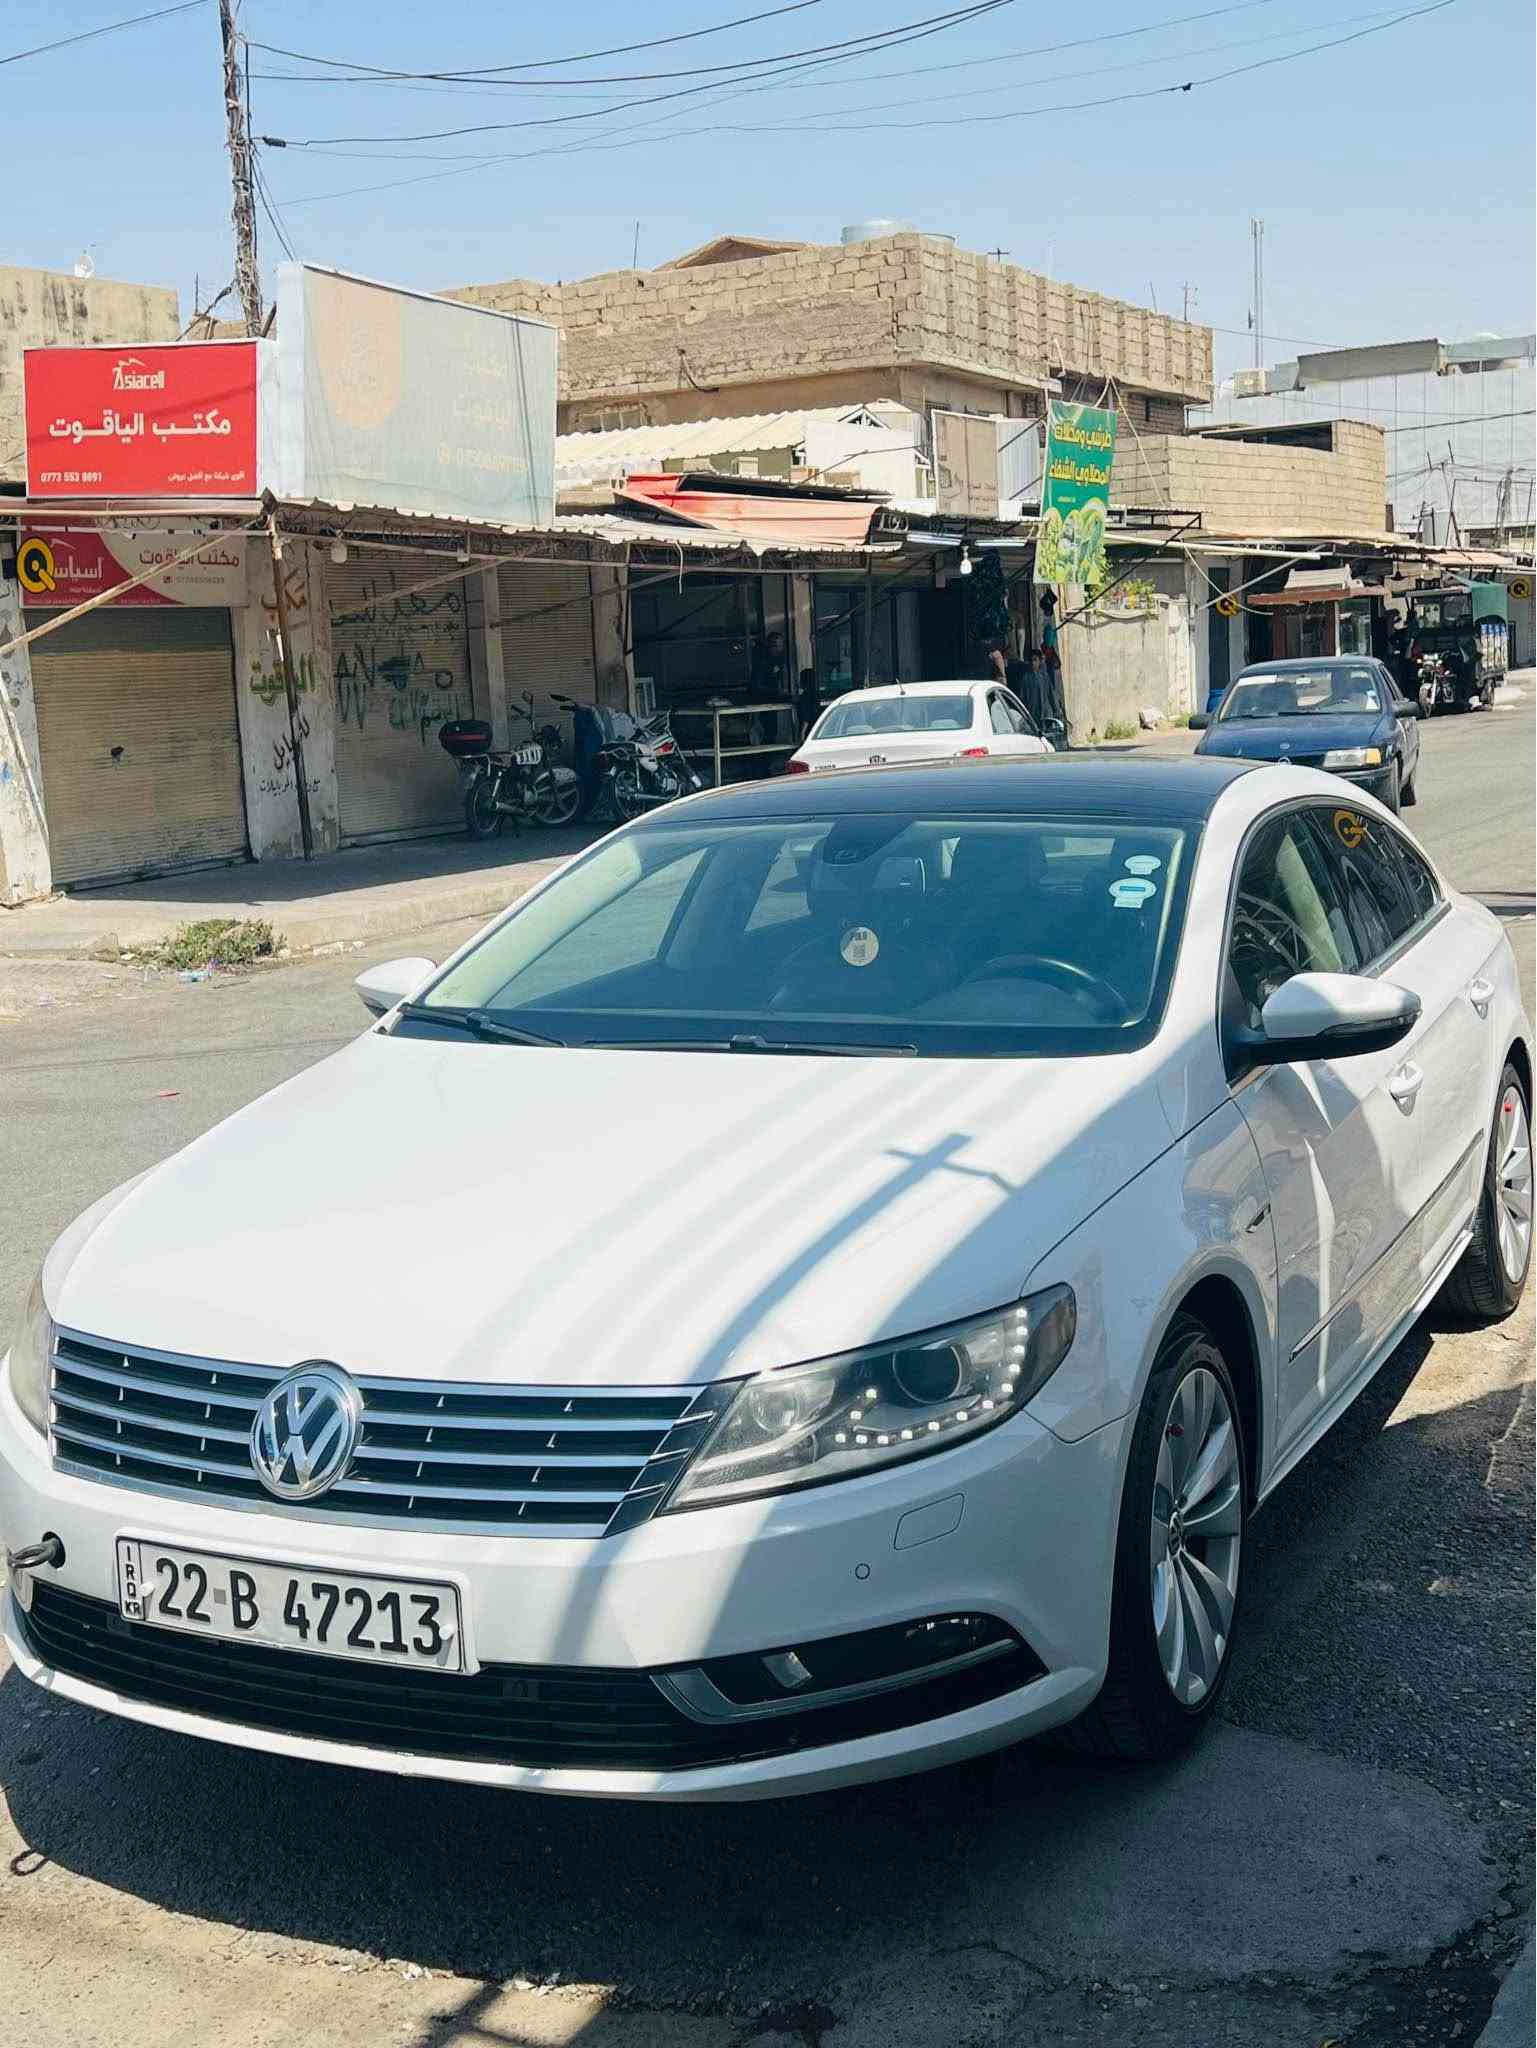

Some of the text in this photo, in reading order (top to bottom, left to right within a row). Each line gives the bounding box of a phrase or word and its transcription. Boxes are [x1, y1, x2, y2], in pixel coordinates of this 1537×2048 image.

[112, 365, 166, 390] Asiacell
[48, 408, 232, 444] مكتب الياقوت
[197, 549, 239, 570] مكتب
[256, 1378, 348, 1495] VW
[155, 1557, 443, 1657] 22 B 47213
